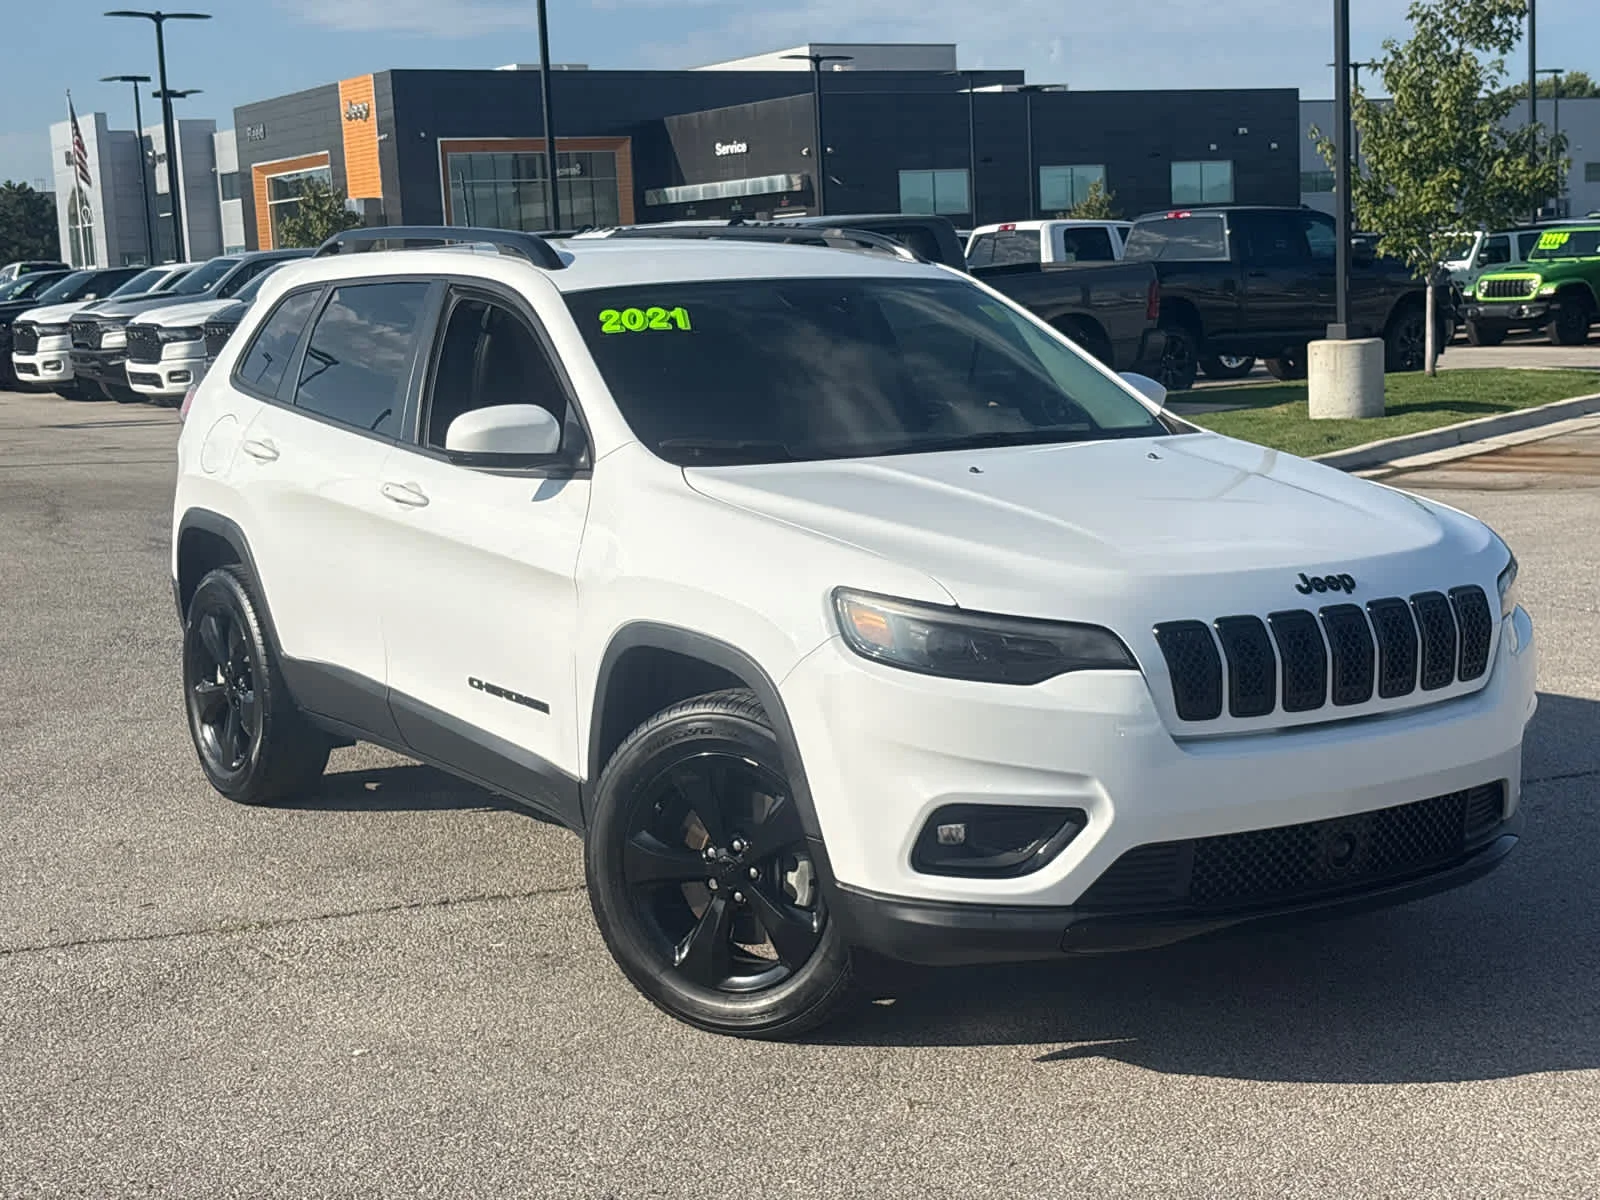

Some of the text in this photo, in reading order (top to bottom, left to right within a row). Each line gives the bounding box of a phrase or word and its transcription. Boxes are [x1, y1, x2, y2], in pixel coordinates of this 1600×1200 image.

[714, 140, 748, 156] Service
[599, 306, 692, 334] 2021
[1295, 572, 1356, 595] Jeep
